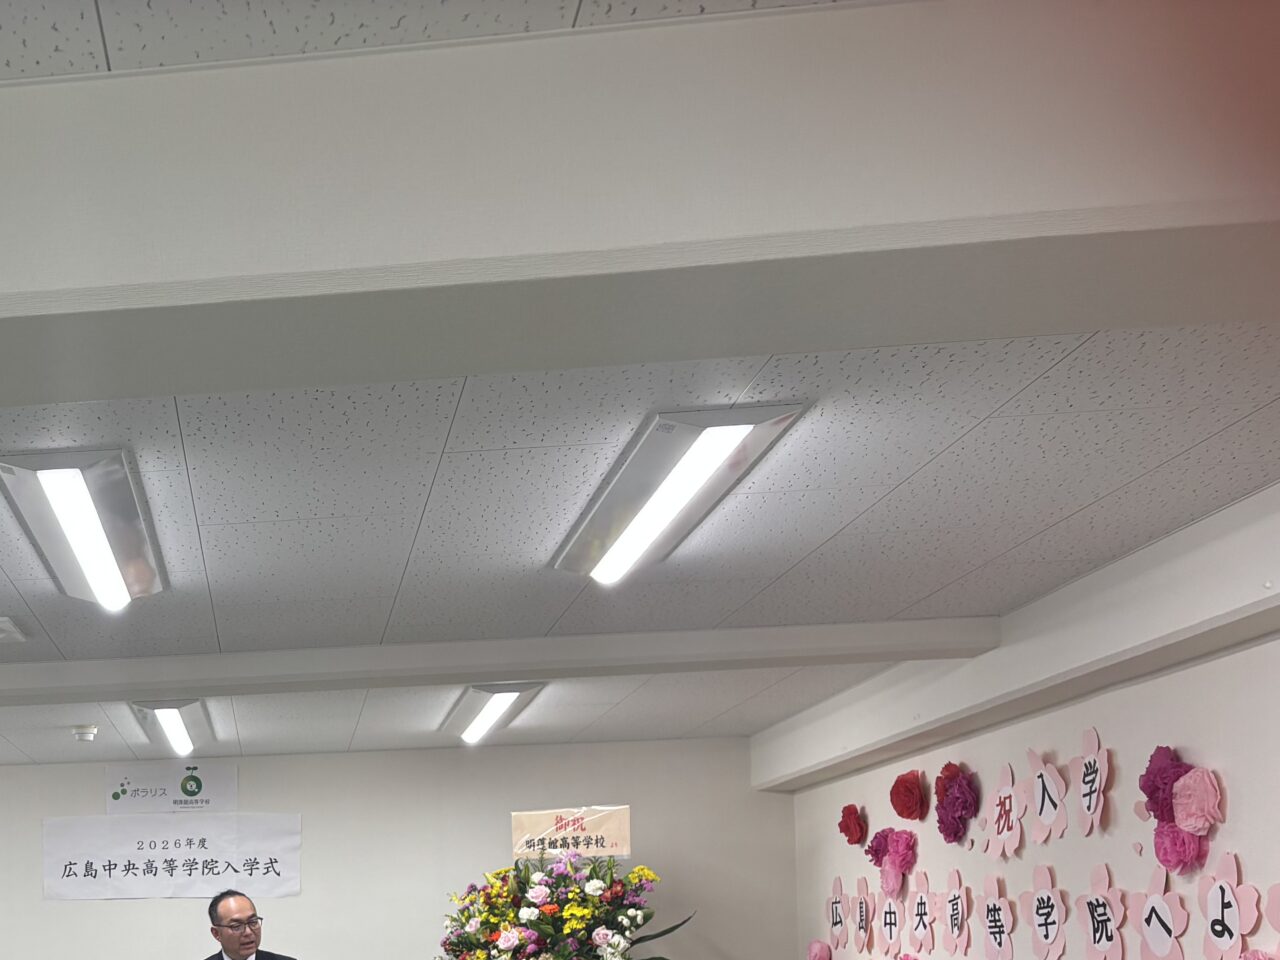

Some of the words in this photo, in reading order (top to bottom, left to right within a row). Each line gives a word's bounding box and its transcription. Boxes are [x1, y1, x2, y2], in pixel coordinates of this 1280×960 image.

[130, 788, 167, 798] ポラリス
[137, 837, 208, 851] 2026年度
[61, 857, 281, 879] 広島中央高等学院入学式
